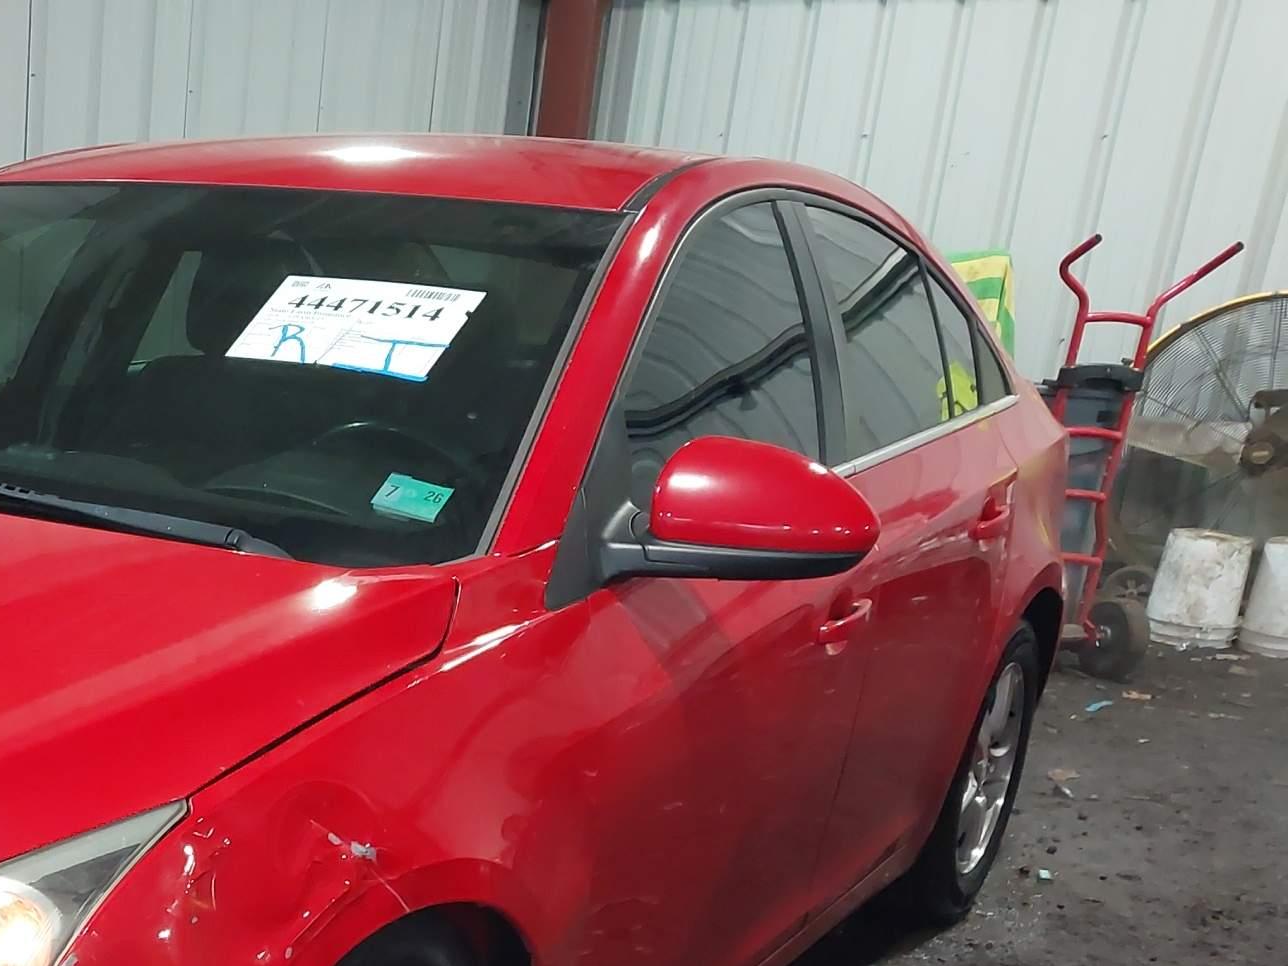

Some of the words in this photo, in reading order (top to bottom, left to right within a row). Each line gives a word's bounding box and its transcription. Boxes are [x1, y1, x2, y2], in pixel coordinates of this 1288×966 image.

[287, 294, 446, 322] 44471514
[268, 323, 306, 363] R
[385, 484, 401, 498] 7
[423, 490, 445, 504] 26
